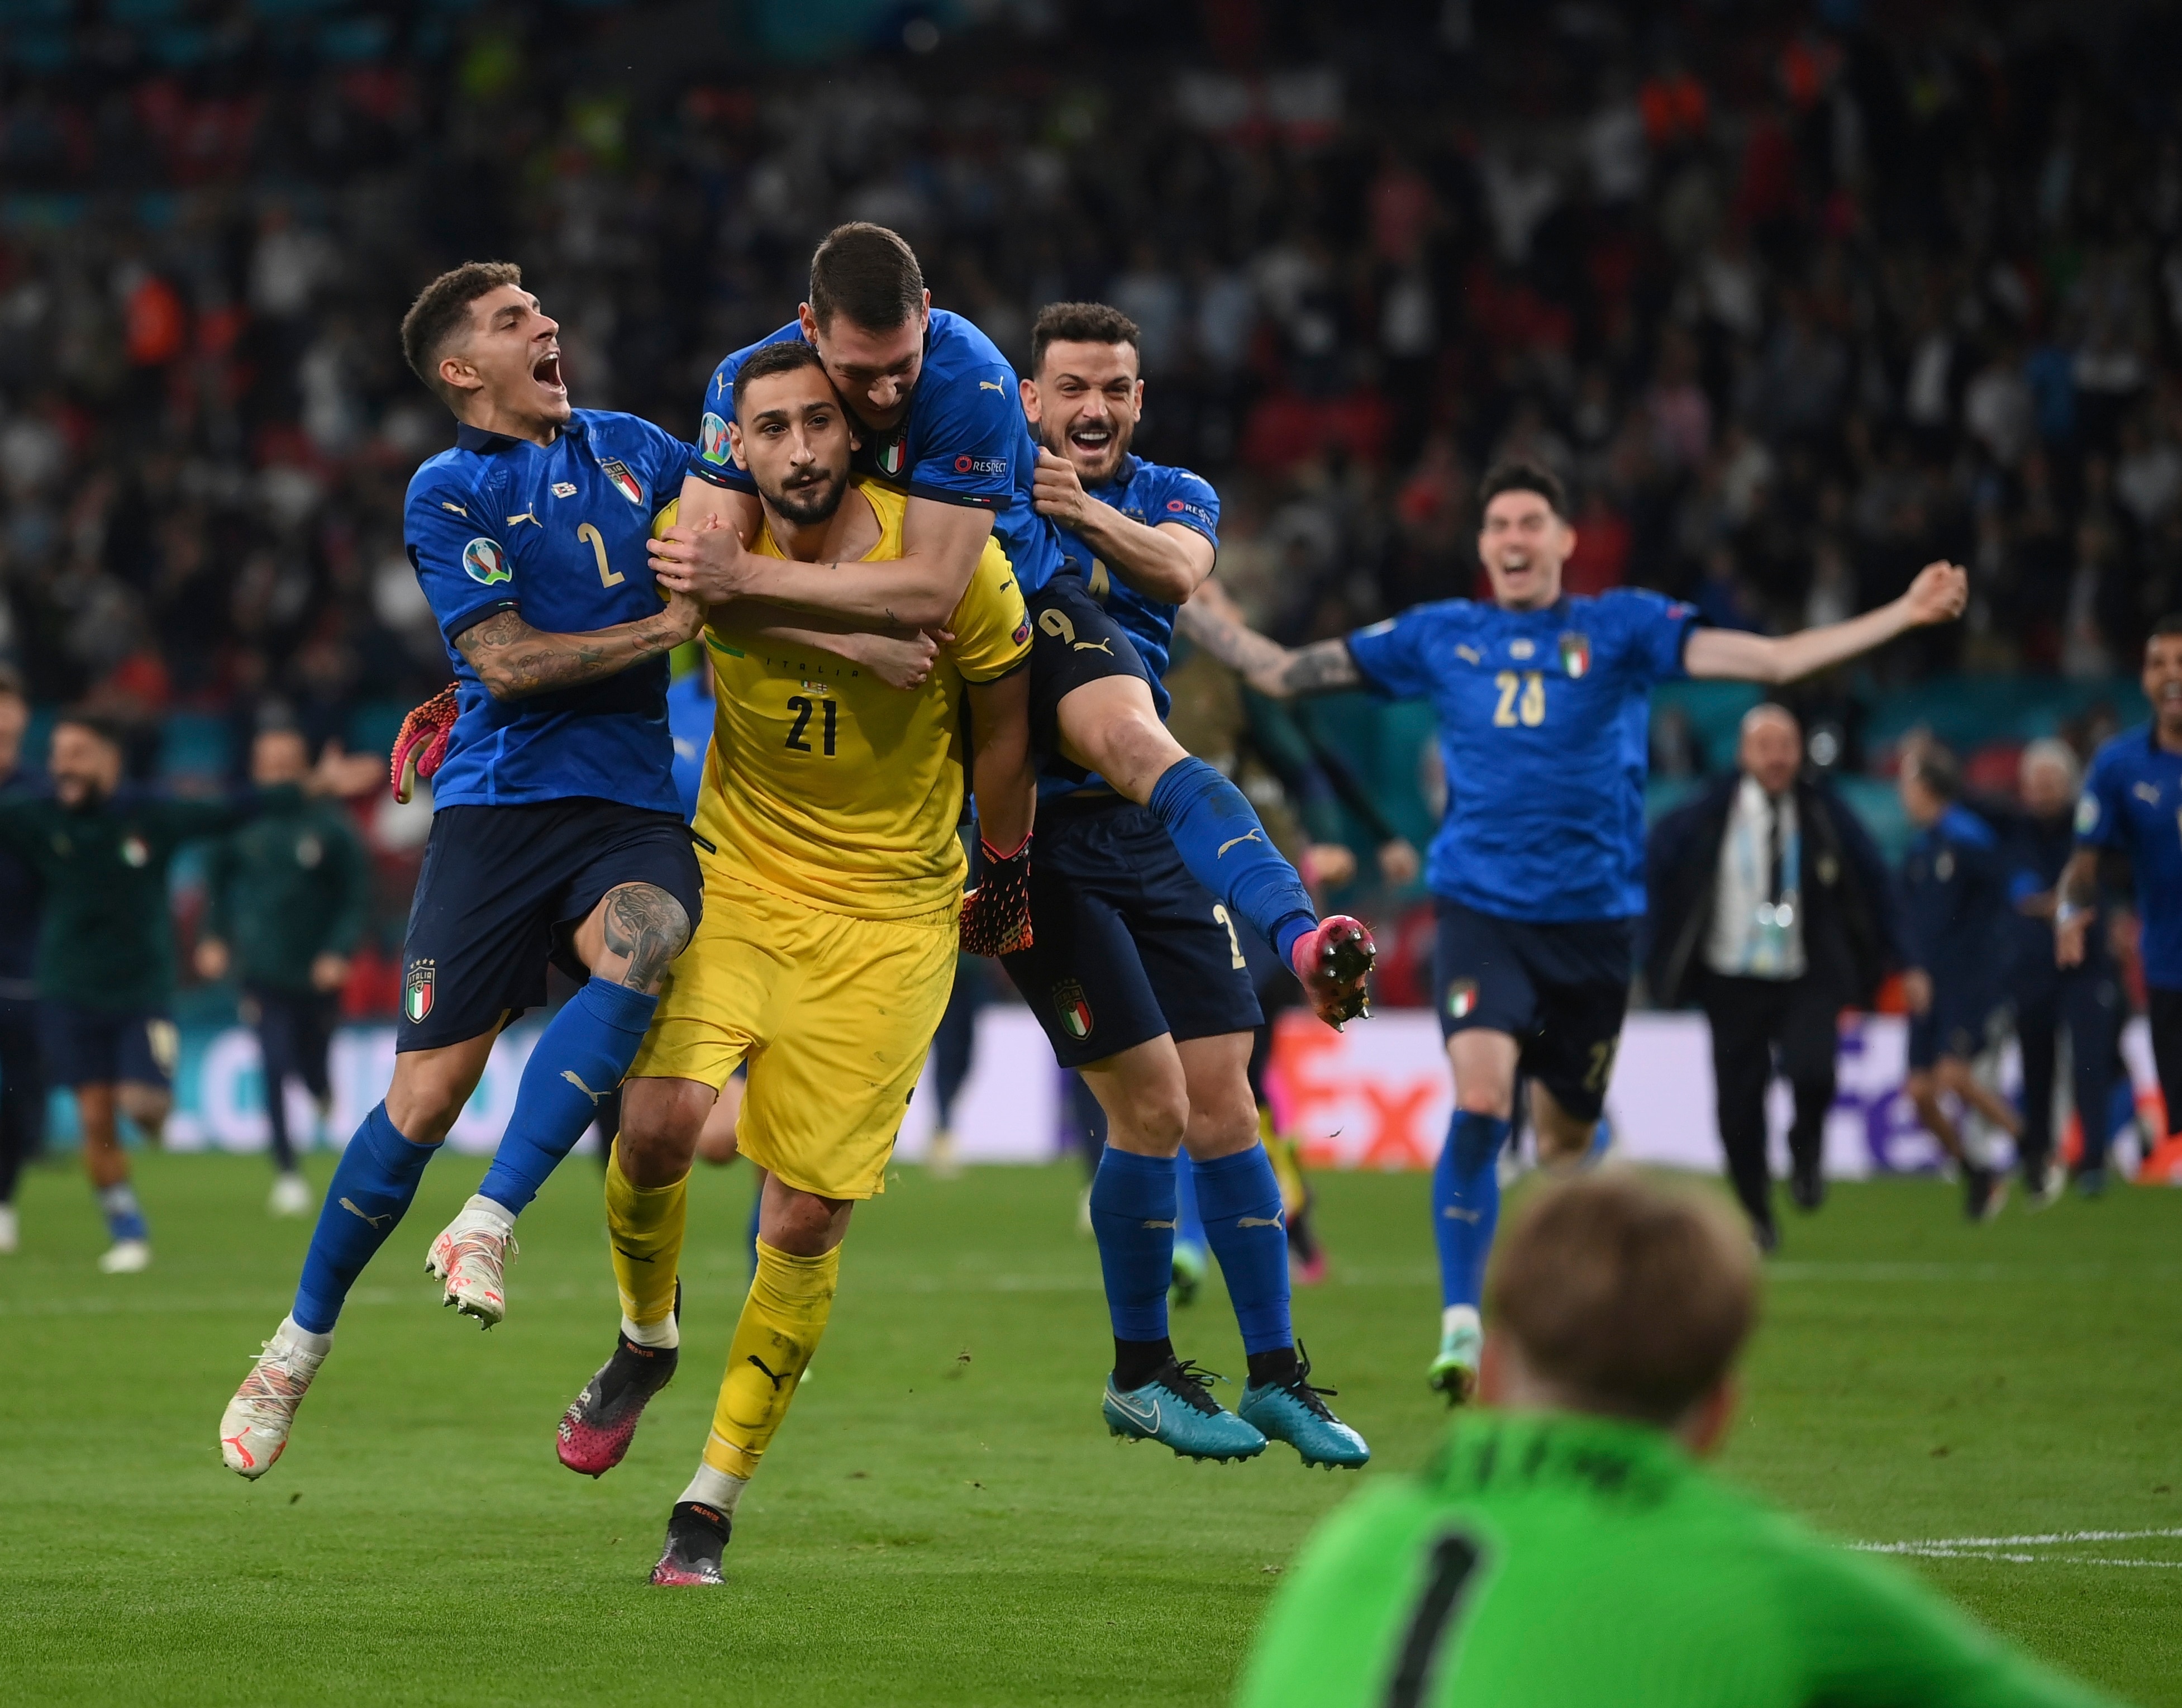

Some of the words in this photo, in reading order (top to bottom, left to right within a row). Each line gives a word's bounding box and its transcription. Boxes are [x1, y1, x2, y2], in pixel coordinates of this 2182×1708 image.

[973, 461, 1007, 473] RESPECT
[577, 522, 626, 589] 2
[1038, 608, 1076, 645] 9
[766, 658, 859, 678] ITALIA
[784, 695, 837, 755] 21
[409, 971, 432, 984] ITALIA
